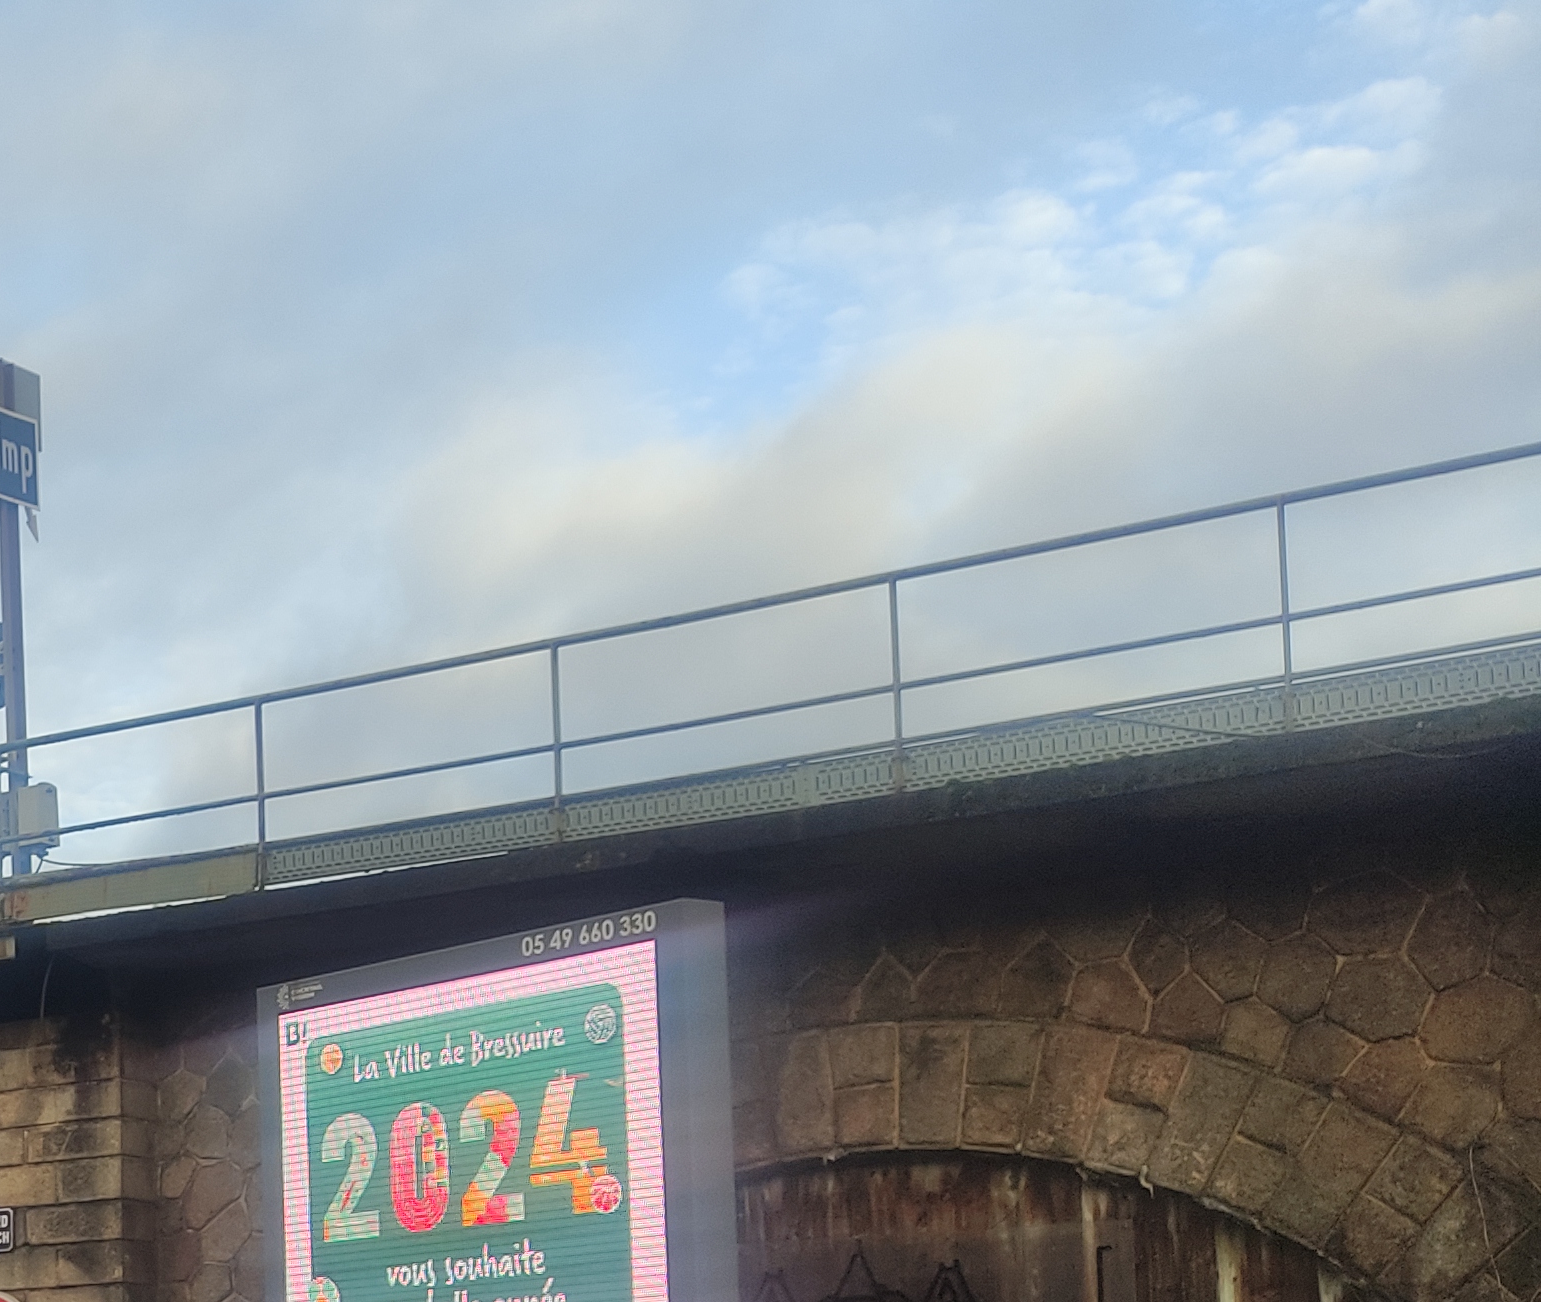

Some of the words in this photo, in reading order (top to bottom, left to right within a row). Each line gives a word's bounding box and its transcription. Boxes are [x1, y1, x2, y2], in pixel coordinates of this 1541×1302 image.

[521, 934, 545, 957] 05
[549, 928, 573, 950] 49
[579, 919, 615, 945] 660
[619, 910, 657, 937] 330
[352, 1054, 380, 1083] La
[384, 1042, 432, 1078] Ville
[438, 1032, 465, 1066] de
[469, 1020, 566, 1067] Bressuire
[320, 1075, 622, 1243] 2024
[386, 1258, 437, 1287] vous
[444, 1237, 546, 1285] souhaite
